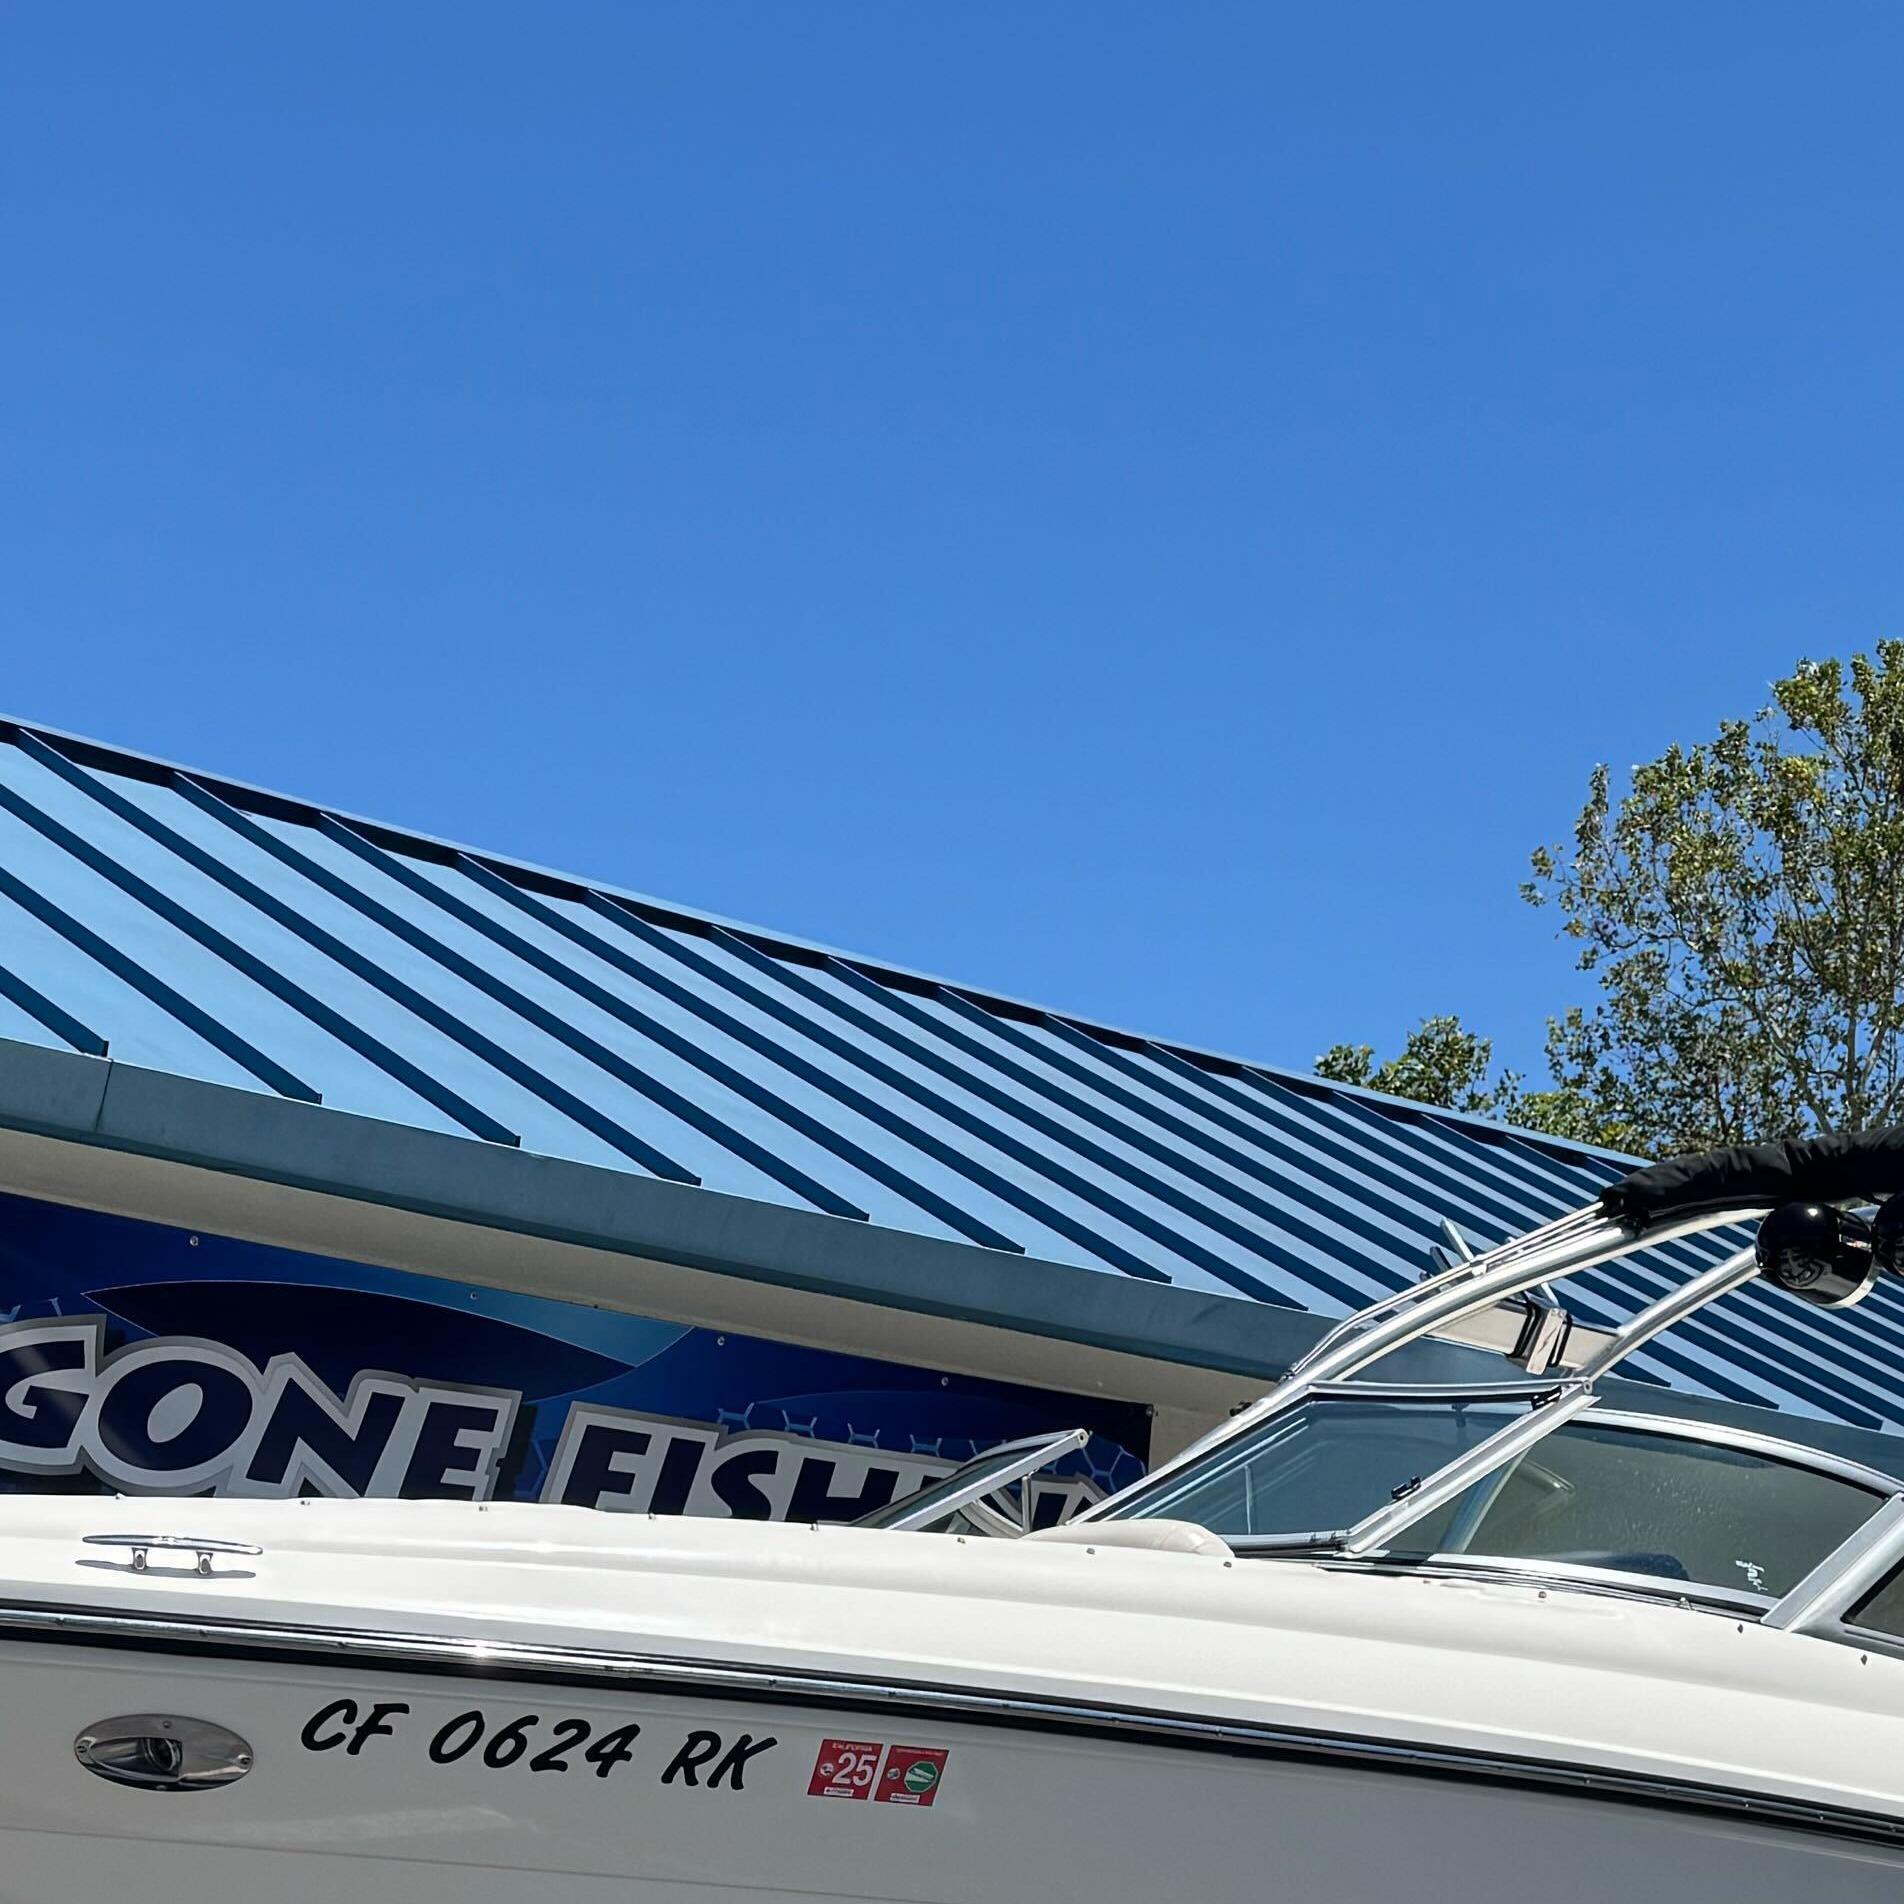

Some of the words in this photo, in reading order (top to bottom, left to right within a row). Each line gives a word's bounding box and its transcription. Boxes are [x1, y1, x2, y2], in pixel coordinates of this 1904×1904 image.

[300, 1698, 410, 1756] CF
[428, 1710, 641, 1778] 0624
[660, 1729, 779, 1791] RK
[832, 1752, 878, 1787] 25
